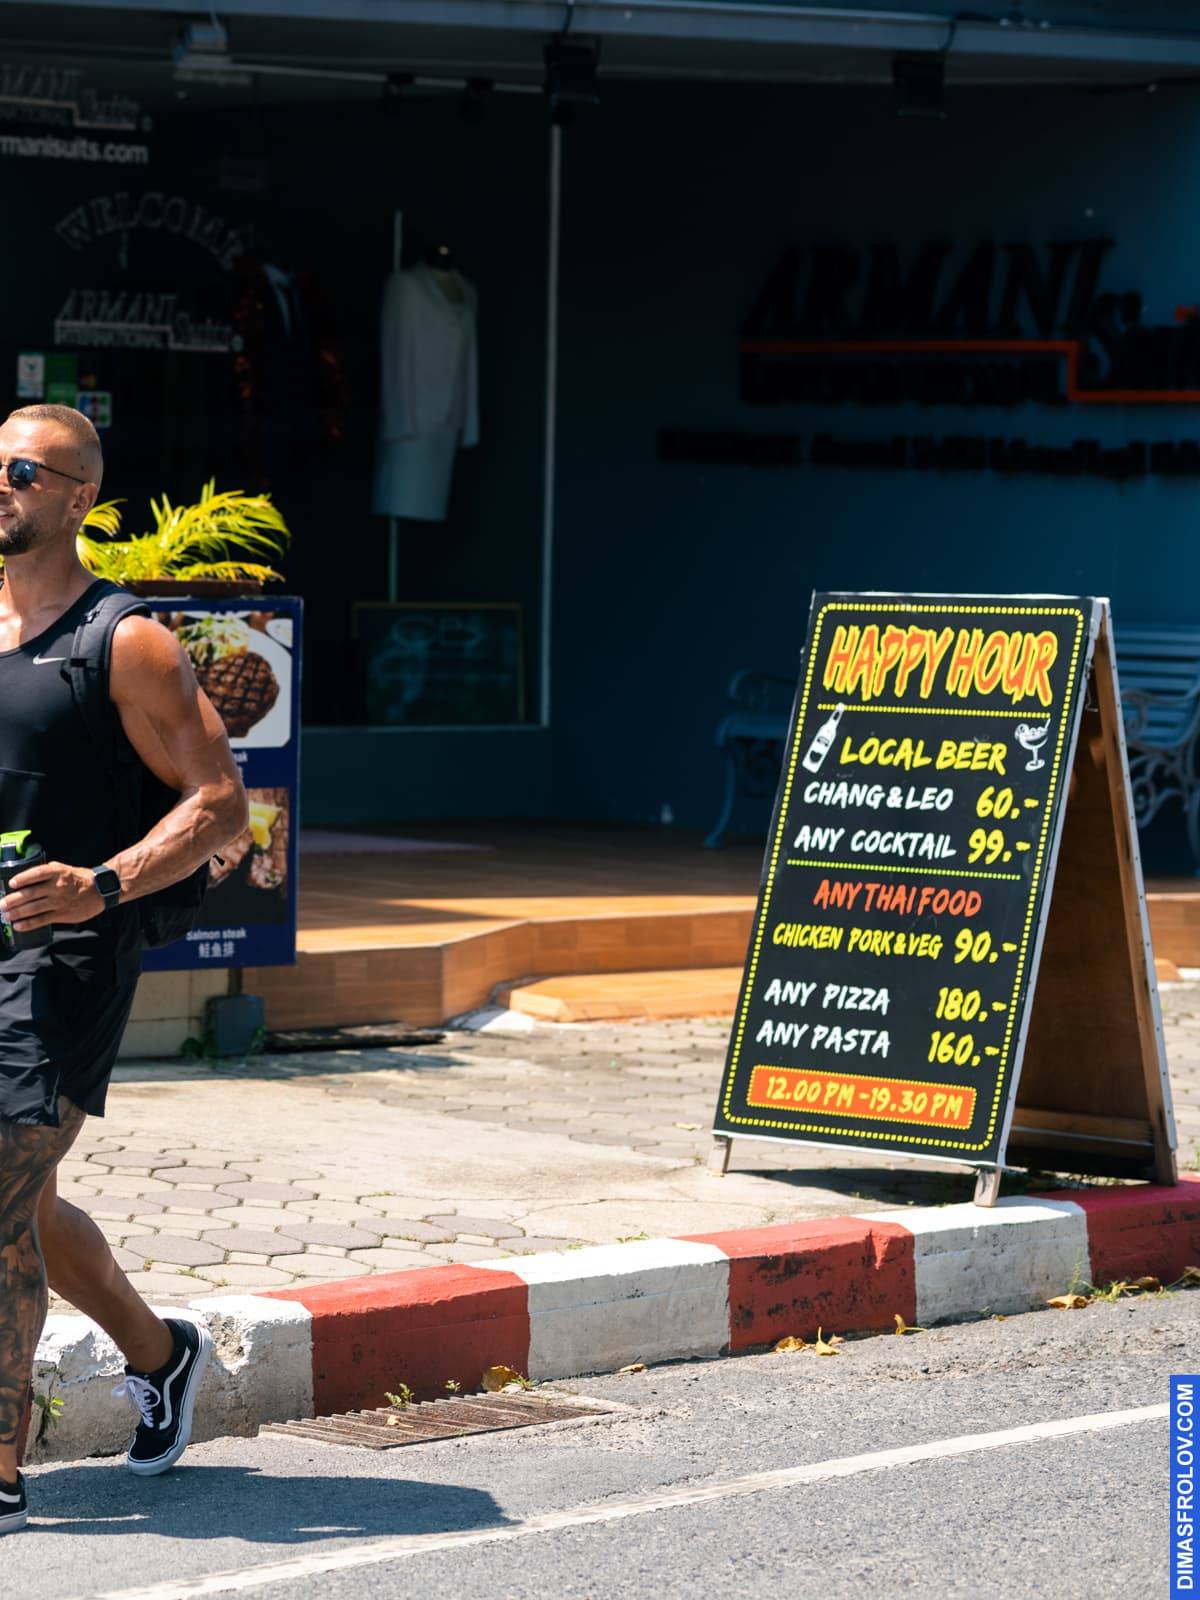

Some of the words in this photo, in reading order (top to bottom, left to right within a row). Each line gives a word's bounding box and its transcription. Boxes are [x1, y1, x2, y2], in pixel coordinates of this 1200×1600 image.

[823, 625, 954, 701] HAPPY
[946, 628, 1057, 706] HOUR
[839, 736, 931, 771] LOCAL
[935, 741, 1007, 775] BEER
[794, 825, 845, 853] ANY
[851, 829, 956, 859] COCKTAIL
[813, 879, 863, 911] ANY
[864, 883, 917, 915] THAI
[918, 889, 982, 918] FOOD
[186, 930, 220, 941] Salmon
[222, 927, 247, 939] steak
[772, 922, 844, 951] CHICKEN
[764, 978, 817, 1007] ANY
[822, 983, 890, 1015] PIZZA
[756, 1019, 809, 1048] ANY
[811, 1023, 890, 1058] PASTA
[767, 1075, 821, 1103] 12.00
[826, 1081, 856, 1109] PM
[930, 1093, 964, 1119] PM
